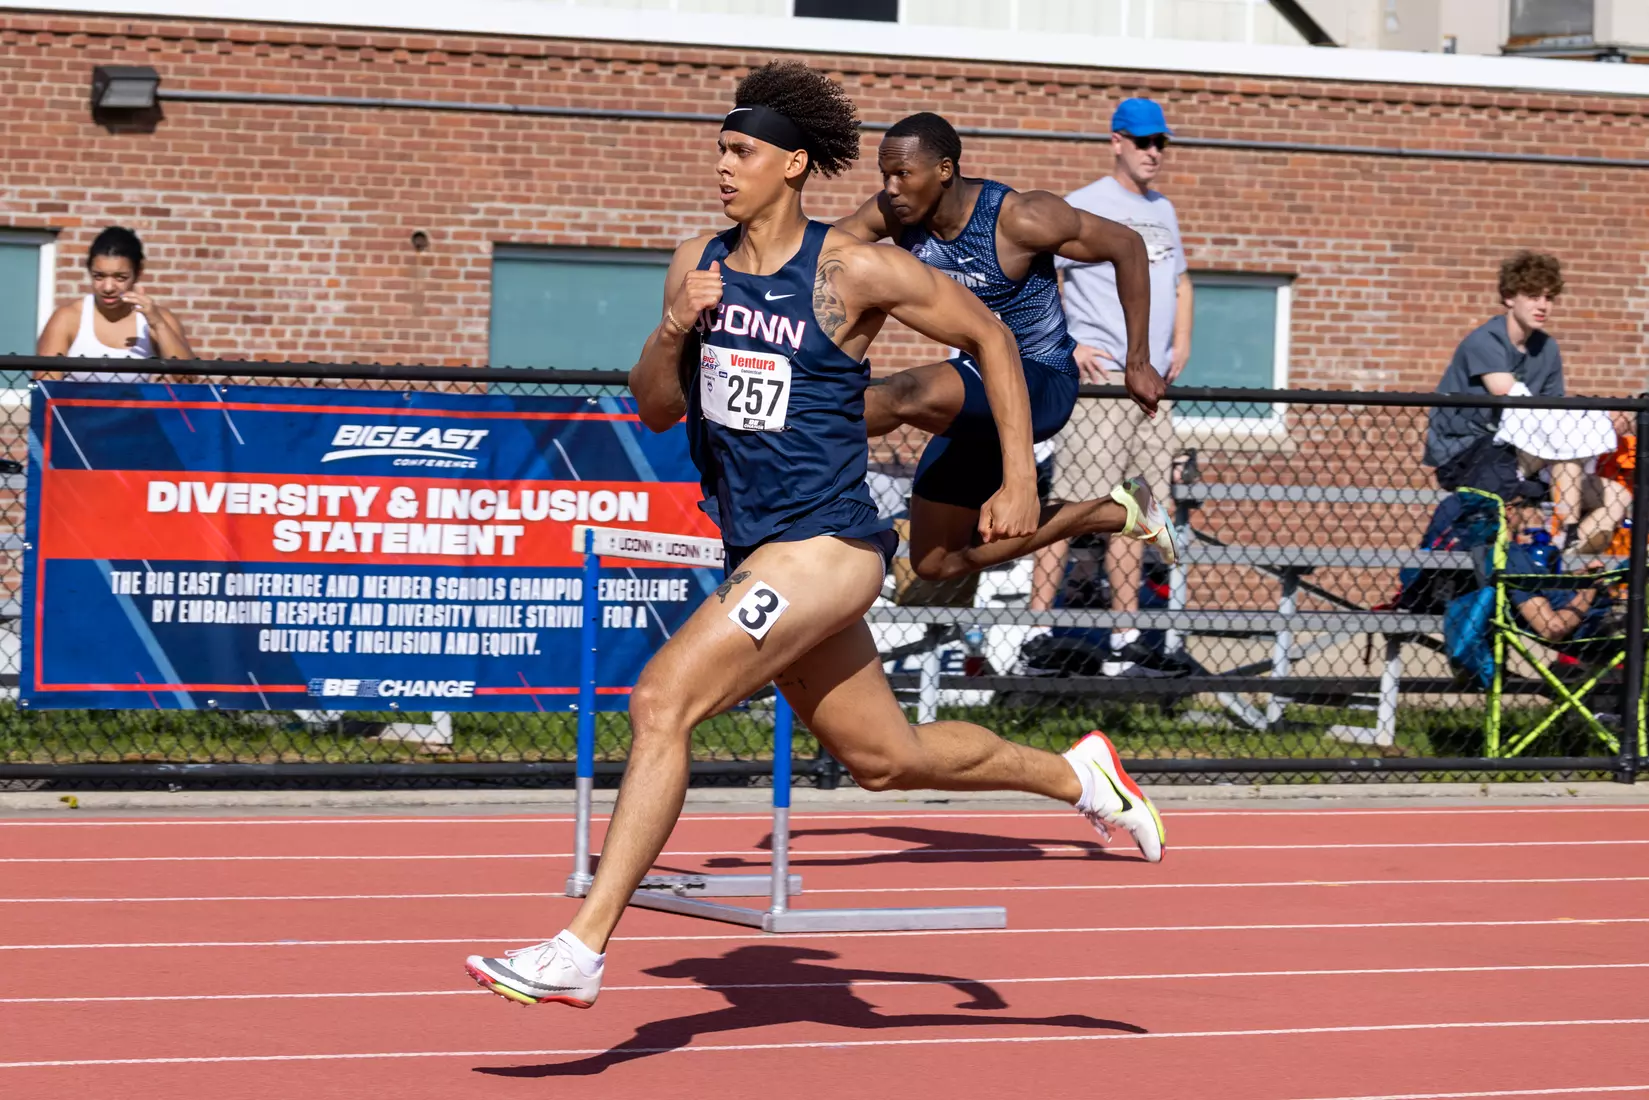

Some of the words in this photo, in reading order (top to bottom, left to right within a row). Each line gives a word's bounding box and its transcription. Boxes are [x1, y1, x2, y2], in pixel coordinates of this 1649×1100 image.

[701, 361, 719, 370] EAST
[703, 355, 716, 364] BIG
[730, 353, 776, 371] Ventura
[727, 374, 784, 417] 257
[393, 459, 478, 469] CONFERENCE
[147, 481, 380, 518] DIVERSITY
[386, 487, 418, 519] &
[426, 488, 649, 522] INCLUSION
[272, 520, 524, 556] STATEMENT
[110, 571, 142, 595] THE
[146, 572, 174, 595] BIG
[178, 572, 221, 596] EAST
[225, 573, 322, 598] CONFERENCE
[326, 575, 358, 598] AND
[363, 576, 431, 599] MEMBER
[435, 577, 505, 600] SCHOOLS
[510, 578, 583, 601] CHAMPIO
[598, 579, 688, 601] EXCELLENCE
[152, 600, 174, 623] BY
[178, 600, 272, 624] EMBRACING
[276, 603, 347, 625] RESPECT
[350, 604, 383, 626] AND
[387, 604, 473, 627] DIVERSITY
[475, 605, 523, 627] WHILE
[525, 605, 583, 628] STRIVI
[603, 605, 633, 628] FOR
[635, 606, 648, 628] A
[738, 588, 779, 630] 3
[259, 629, 329, 653] CULTURE
[333, 631, 353, 653] OF
[356, 631, 442, 655] INCLUSION
[445, 632, 479, 655] AND
[481, 633, 541, 657] EQUITY.
[323, 679, 360, 697] BE
[378, 680, 476, 698] CHANGE
